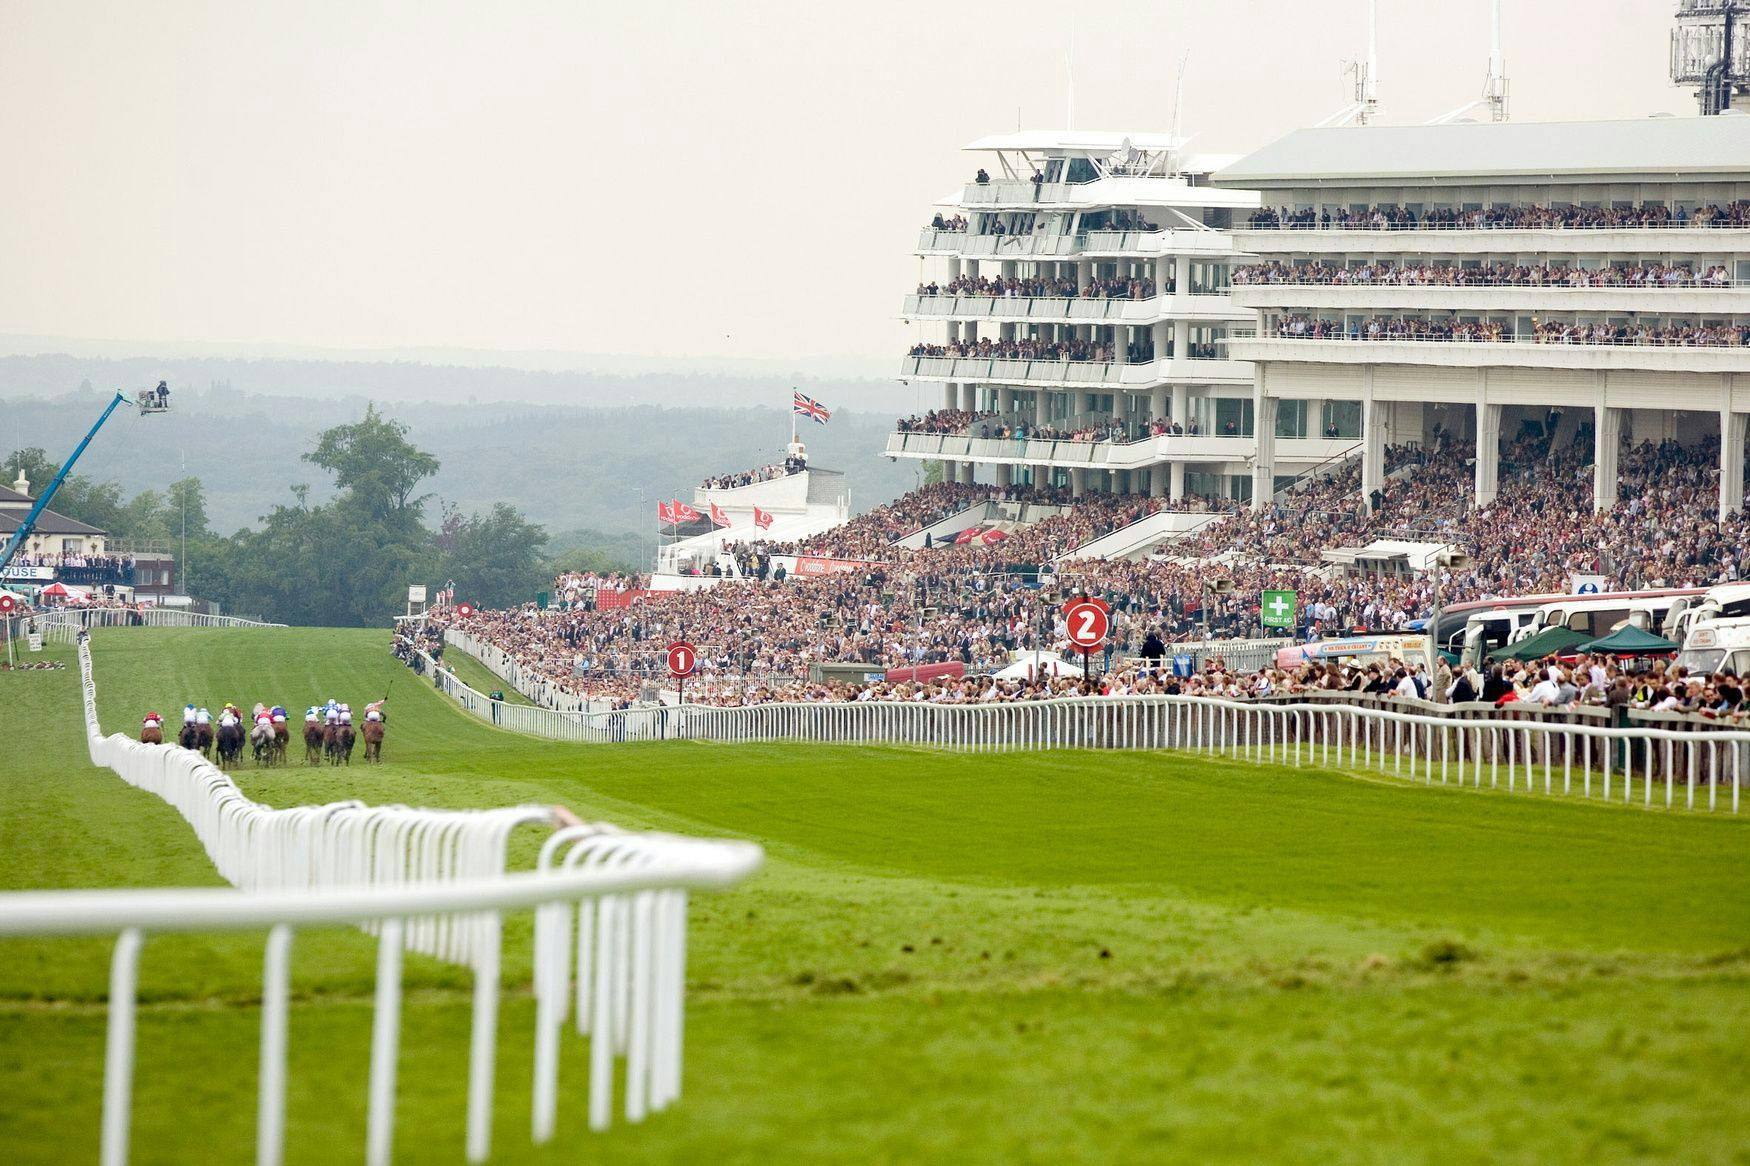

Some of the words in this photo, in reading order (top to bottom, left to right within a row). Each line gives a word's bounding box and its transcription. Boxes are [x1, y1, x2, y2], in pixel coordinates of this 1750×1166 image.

[1076, 610, 1097, 640] 2
[1264, 616, 1283, 624] FIRST
[676, 650, 686, 670] 1
